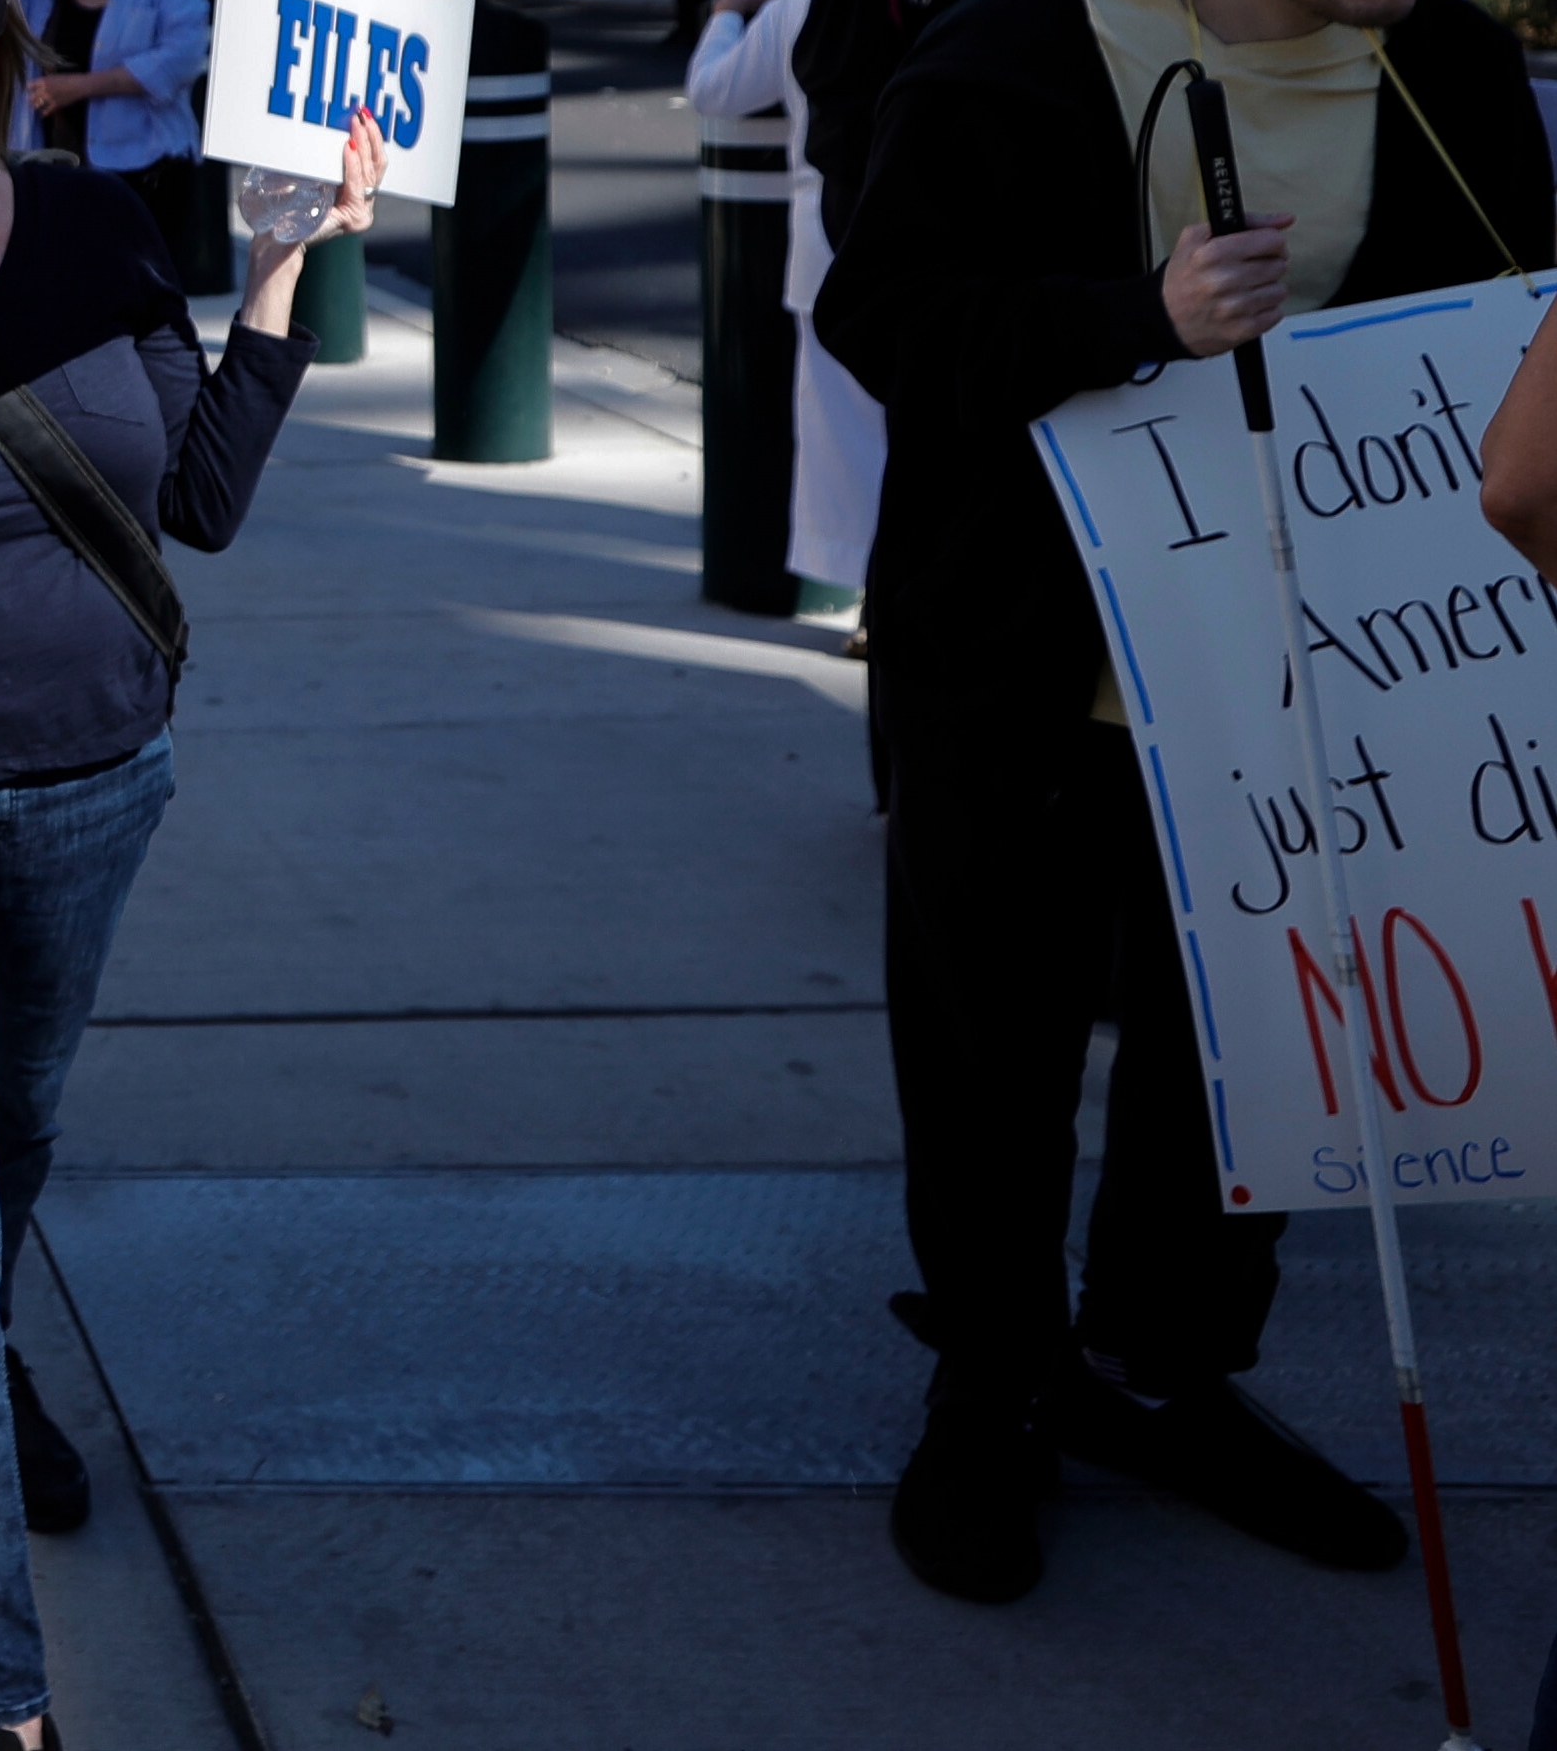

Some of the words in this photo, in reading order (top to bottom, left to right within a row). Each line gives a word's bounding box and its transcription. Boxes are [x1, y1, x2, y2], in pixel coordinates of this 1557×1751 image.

[1213, 156, 1235, 220] REIZEN
[1112, 414, 1230, 551] I
[1294, 353, 1484, 518] don't
[1230, 734, 1405, 917] just
[1287, 906, 1484, 1118] NO
[1312, 1134, 1527, 1196] Sience
